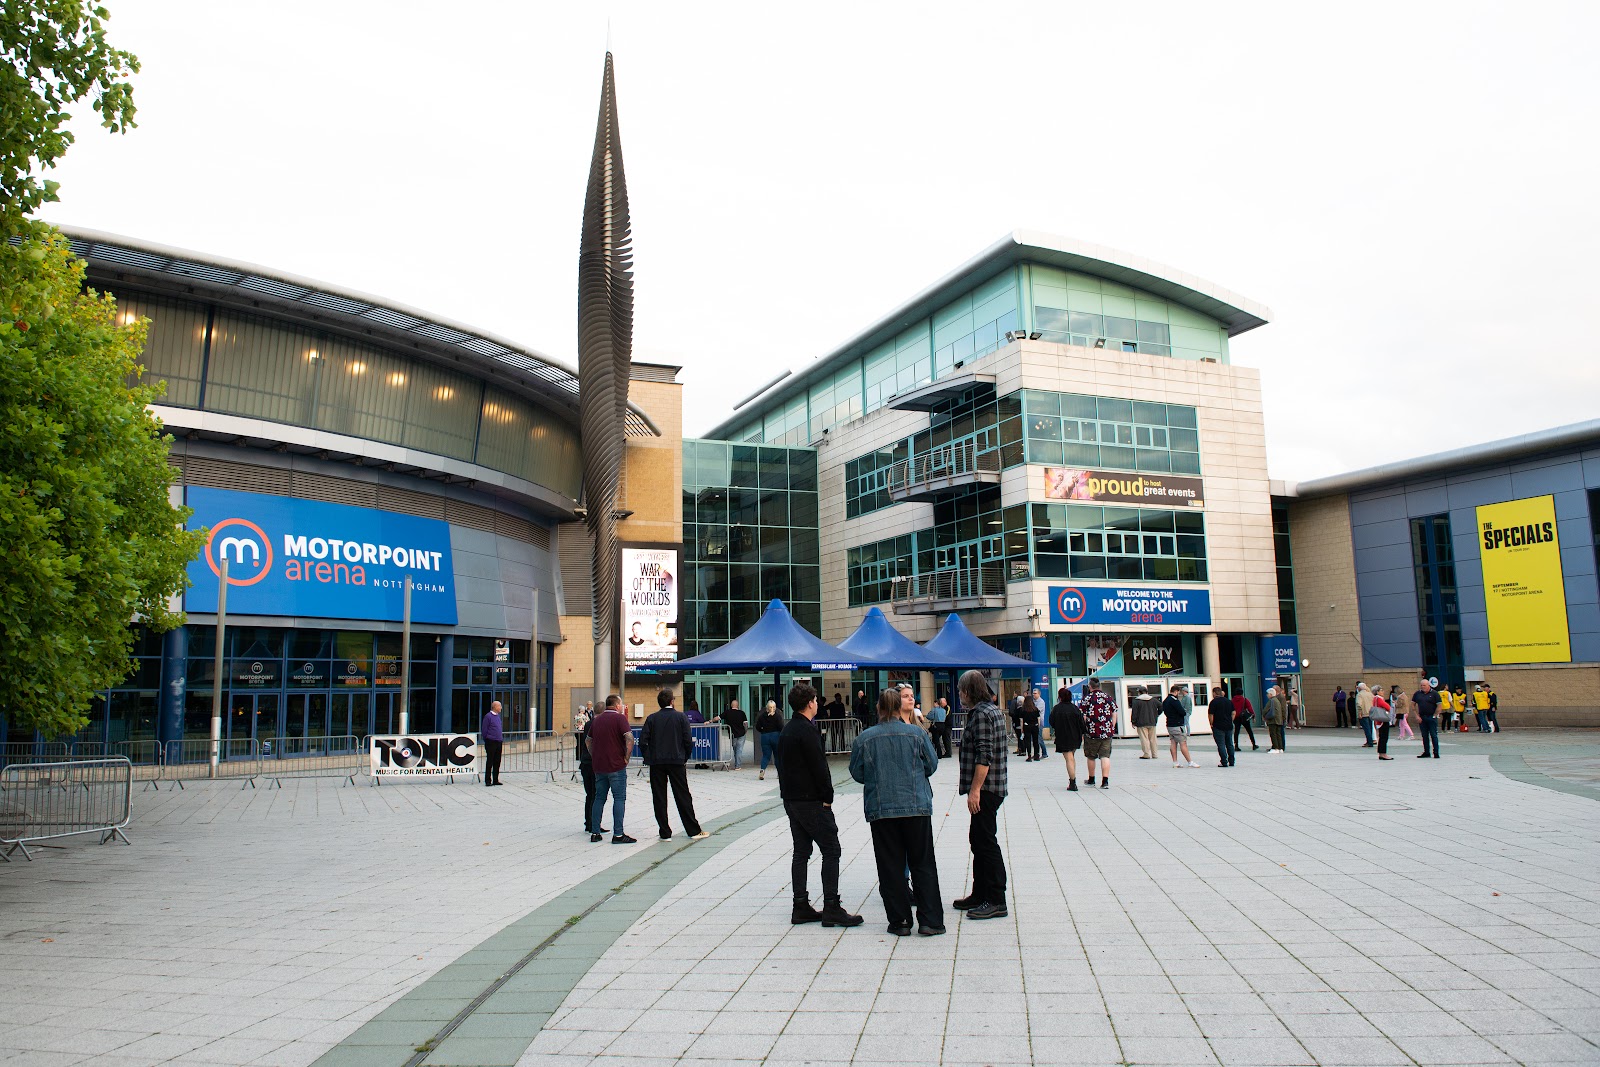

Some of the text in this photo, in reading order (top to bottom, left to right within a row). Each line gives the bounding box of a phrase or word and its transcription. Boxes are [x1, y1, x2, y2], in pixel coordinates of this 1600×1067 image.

[1088, 477, 1144, 497] proud
[1144, 487, 1196, 497] great events
[1484, 522, 1553, 550] SPECIALS
[284, 534, 442, 571] MOTORPOINT
[286, 559, 445, 592] arena NOTTNGHAM
[640, 563, 660, 576] WAR
[633, 578, 666, 591] OF THE
[630, 592, 670, 606] WORLDS
[1102, 599, 1188, 612] MOTORPOINT
[1131, 612, 1163, 623] arena
[1133, 647, 1173, 660] PARTY
[1158, 660, 1172, 669] time
[695, 739, 710, 747] AREA
[375, 736, 474, 768] TONIC
